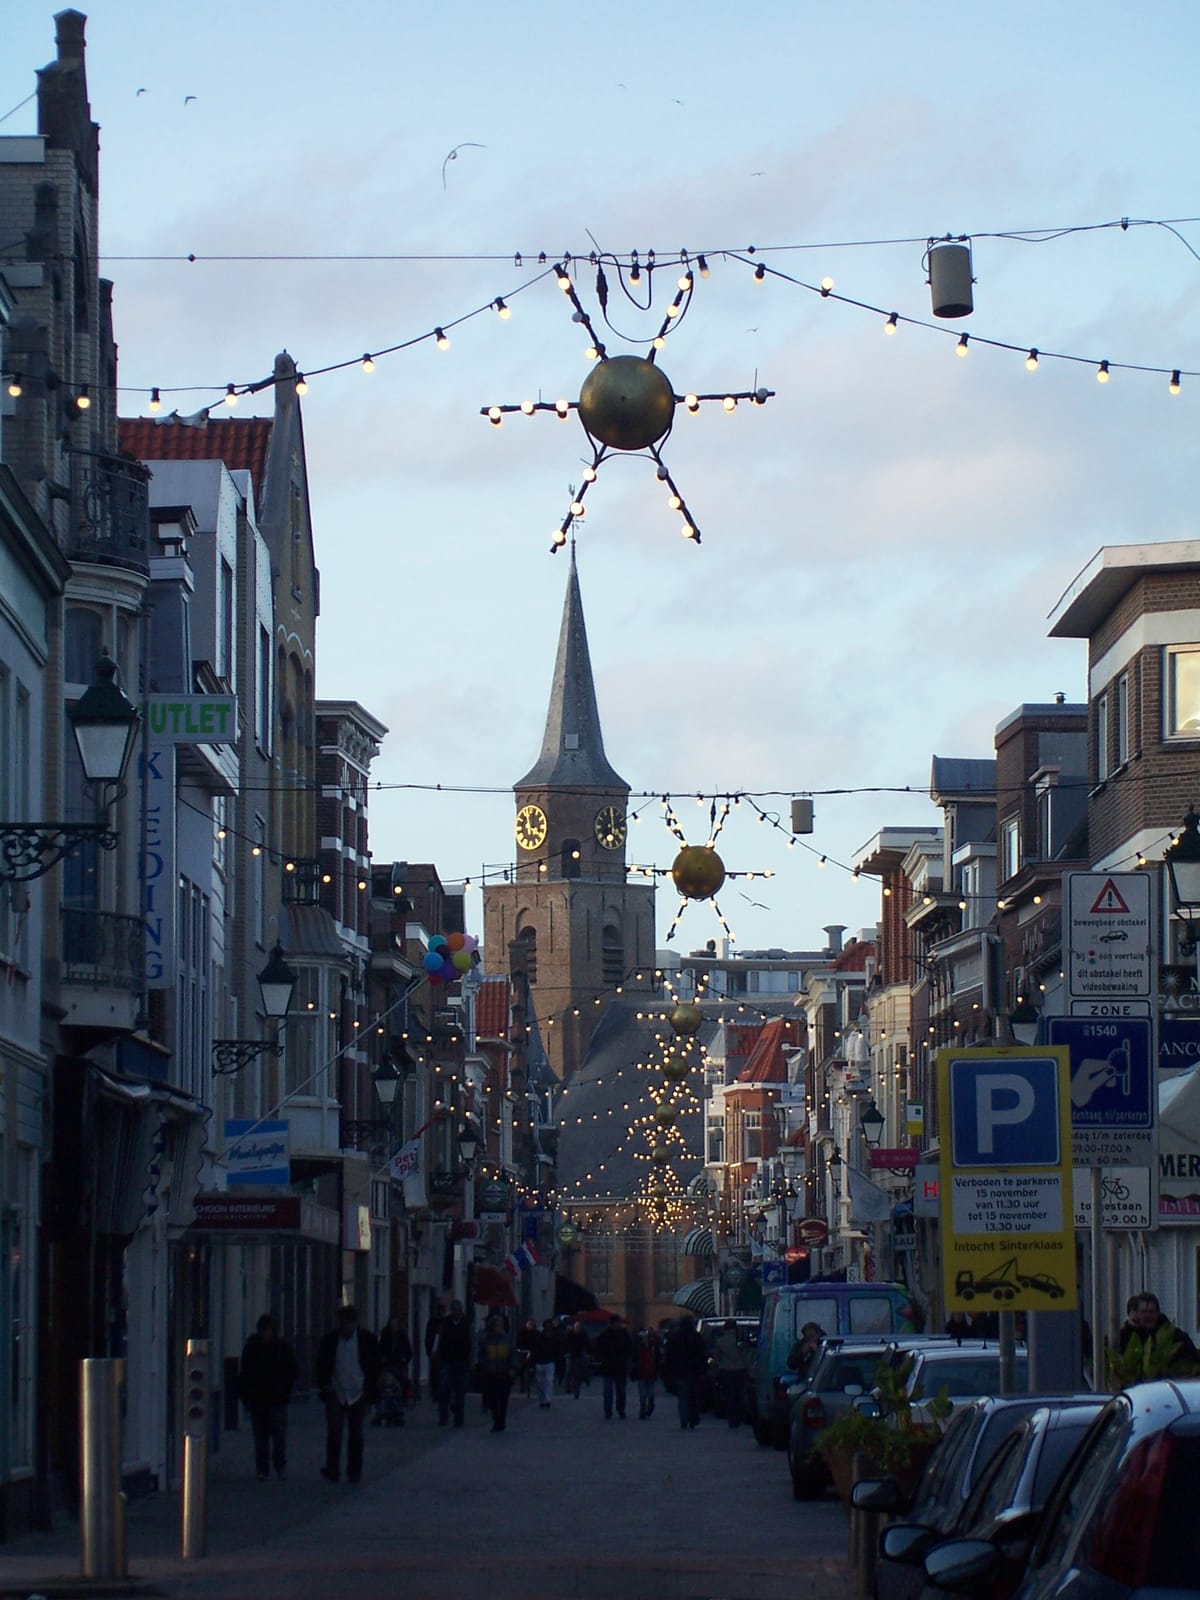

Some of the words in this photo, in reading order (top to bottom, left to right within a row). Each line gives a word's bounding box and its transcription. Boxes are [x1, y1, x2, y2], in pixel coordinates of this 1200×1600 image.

[138, 703, 231, 735] UTLET
[1076, 952, 1085, 962] bij
[1115, 952, 1145, 961] voertuig
[1078, 969, 1088, 978] dit
[1089, 969, 1122, 978] obstakel
[1123, 969, 1143, 978] heeft
[1082, 983, 1138, 993] videobewaking
[1090, 1005, 1132, 1016] ZONE
[1090, 1025, 1117, 1037] 1540
[975, 1074, 1036, 1154] P
[1072, 1132, 1089, 1142] dag
[1092, 1131, 1110, 1140] t/m
[1113, 1132, 1152, 1142] zaterdag
[1097, 1156, 1110, 1164] 60
[955, 1178, 1001, 1187] Verboden
[1003, 1177, 1013, 1186] te
[1016, 1177, 1060, 1187] parkeren
[976, 1190, 988, 1198] 15
[990, 1189, 1038, 1198] november
[996, 1200, 1021, 1209] 11.30
[1023, 1201, 1040, 1209] uur
[1080, 1201, 1142, 1211] toestaan
[968, 1212, 983, 1221] tot
[986, 1212, 997, 1220] 15
[999, 1211, 1047, 1220] november
[1075, 1214, 1138, 1224] 18.-9.00
[1141, 1214, 1147, 1224] h
[1015, 1223, 1032, 1231] uur
[954, 1240, 995, 1251] Intocht
[999, 1239, 1064, 1251] Sinterklaas
